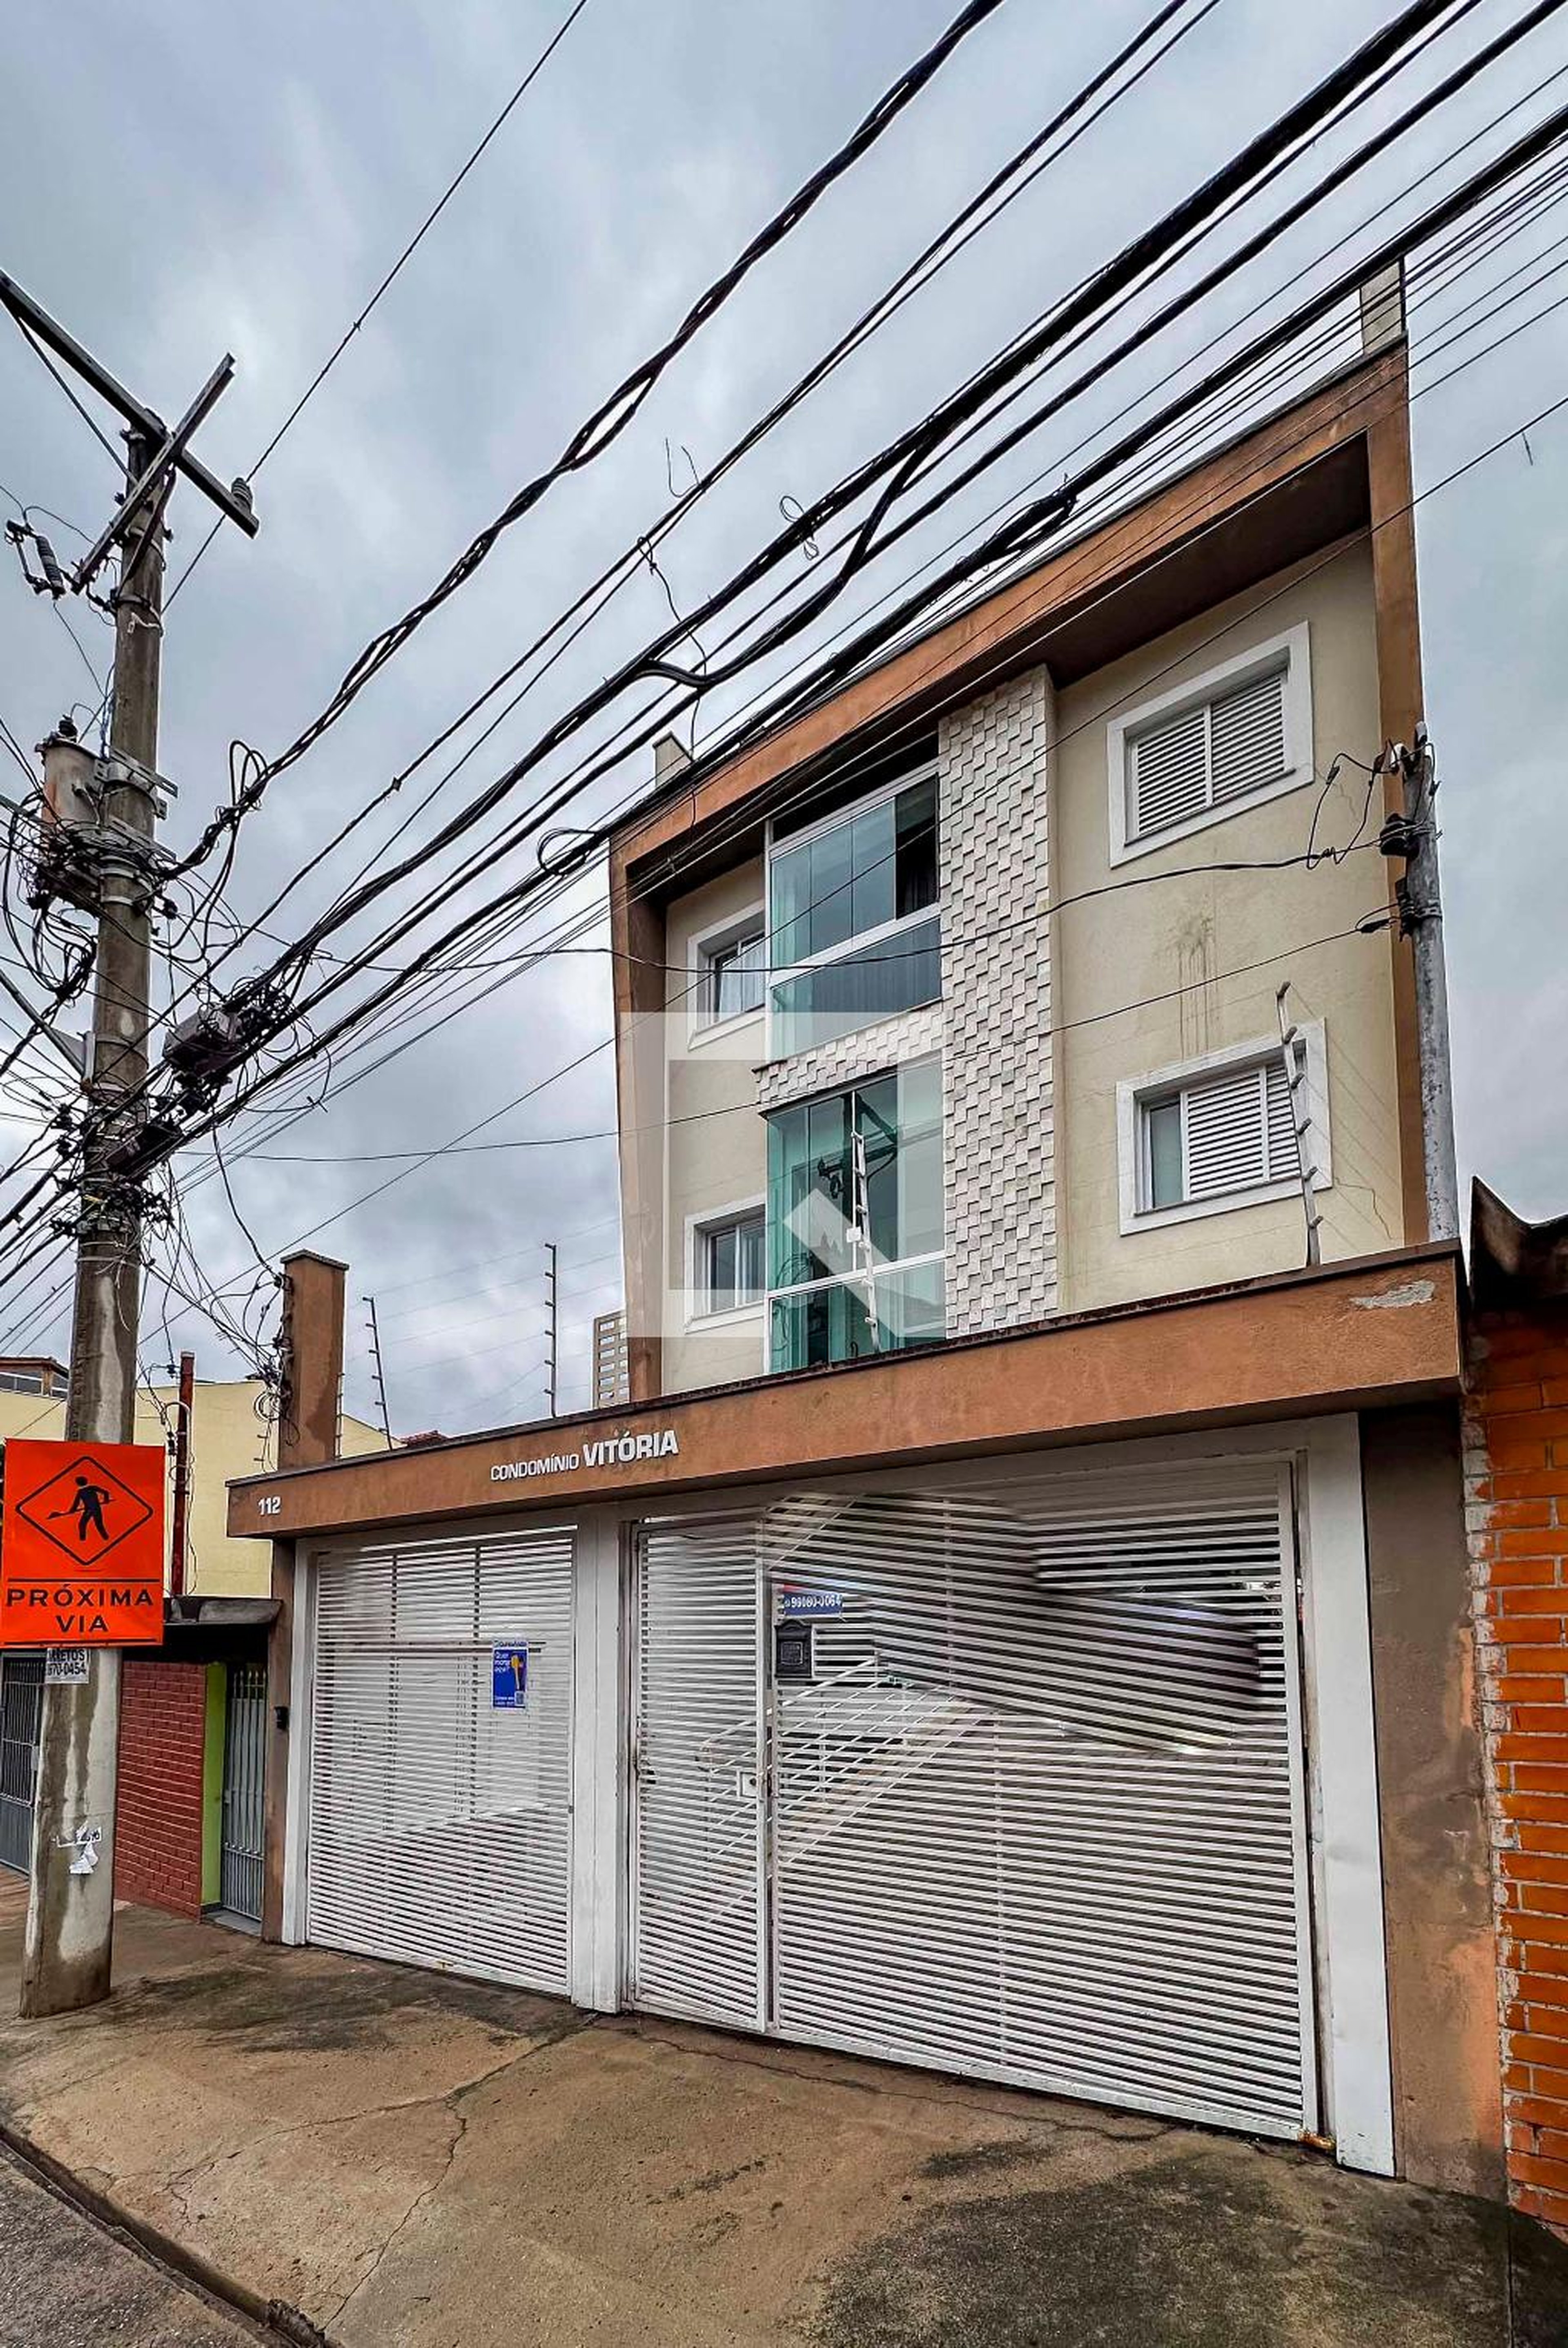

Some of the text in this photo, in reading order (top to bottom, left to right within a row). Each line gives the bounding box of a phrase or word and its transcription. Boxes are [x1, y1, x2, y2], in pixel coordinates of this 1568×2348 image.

[491, 1430, 679, 1481] CONDOMÍNIO VITÓRIA
[258, 1496, 281, 1515] 112
[6, 1584, 153, 1607] PRÓXIMA
[56, 1615, 109, 1633] VIA
